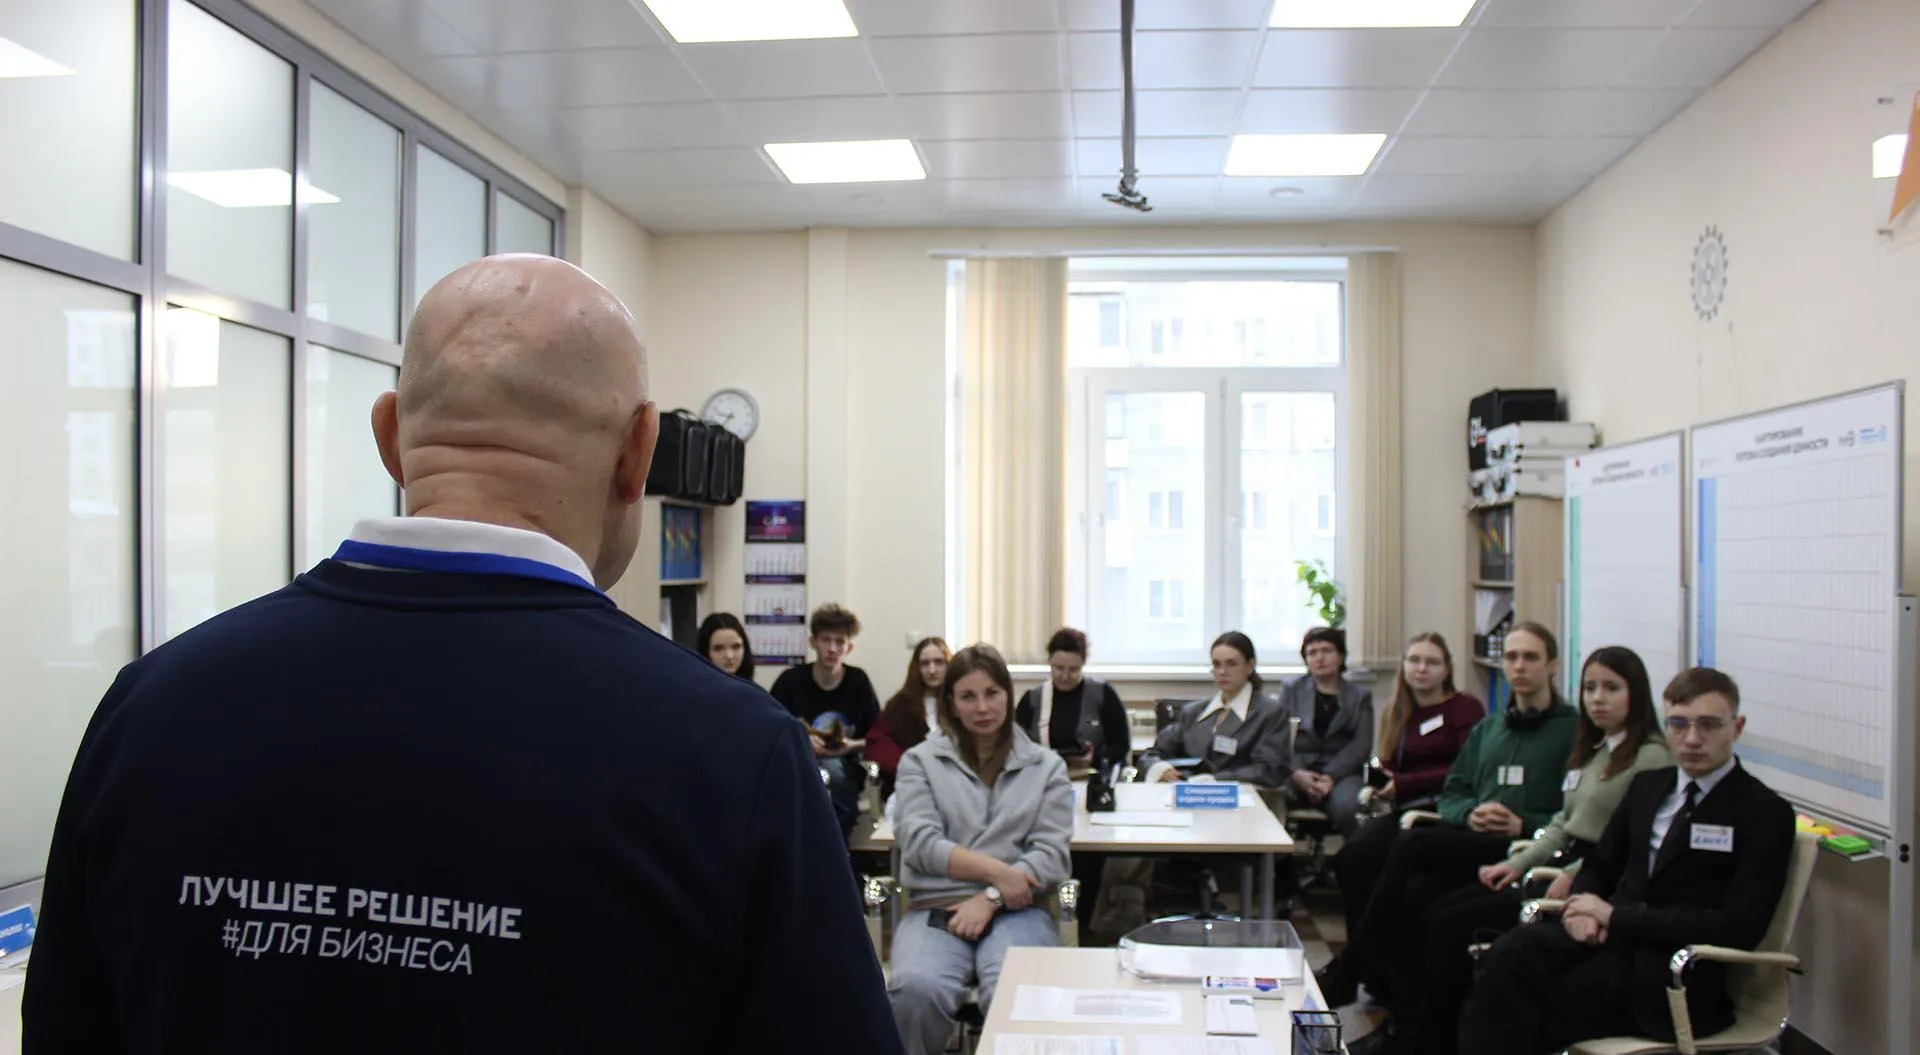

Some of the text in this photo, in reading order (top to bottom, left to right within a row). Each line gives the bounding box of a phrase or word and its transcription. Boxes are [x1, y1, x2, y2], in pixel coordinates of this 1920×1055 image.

[178, 875, 522, 940] ЛУЧШЕЕ РЕШЕНИЕ
[222, 919, 473, 975] #ДЛЯ БИЗНЕСА
